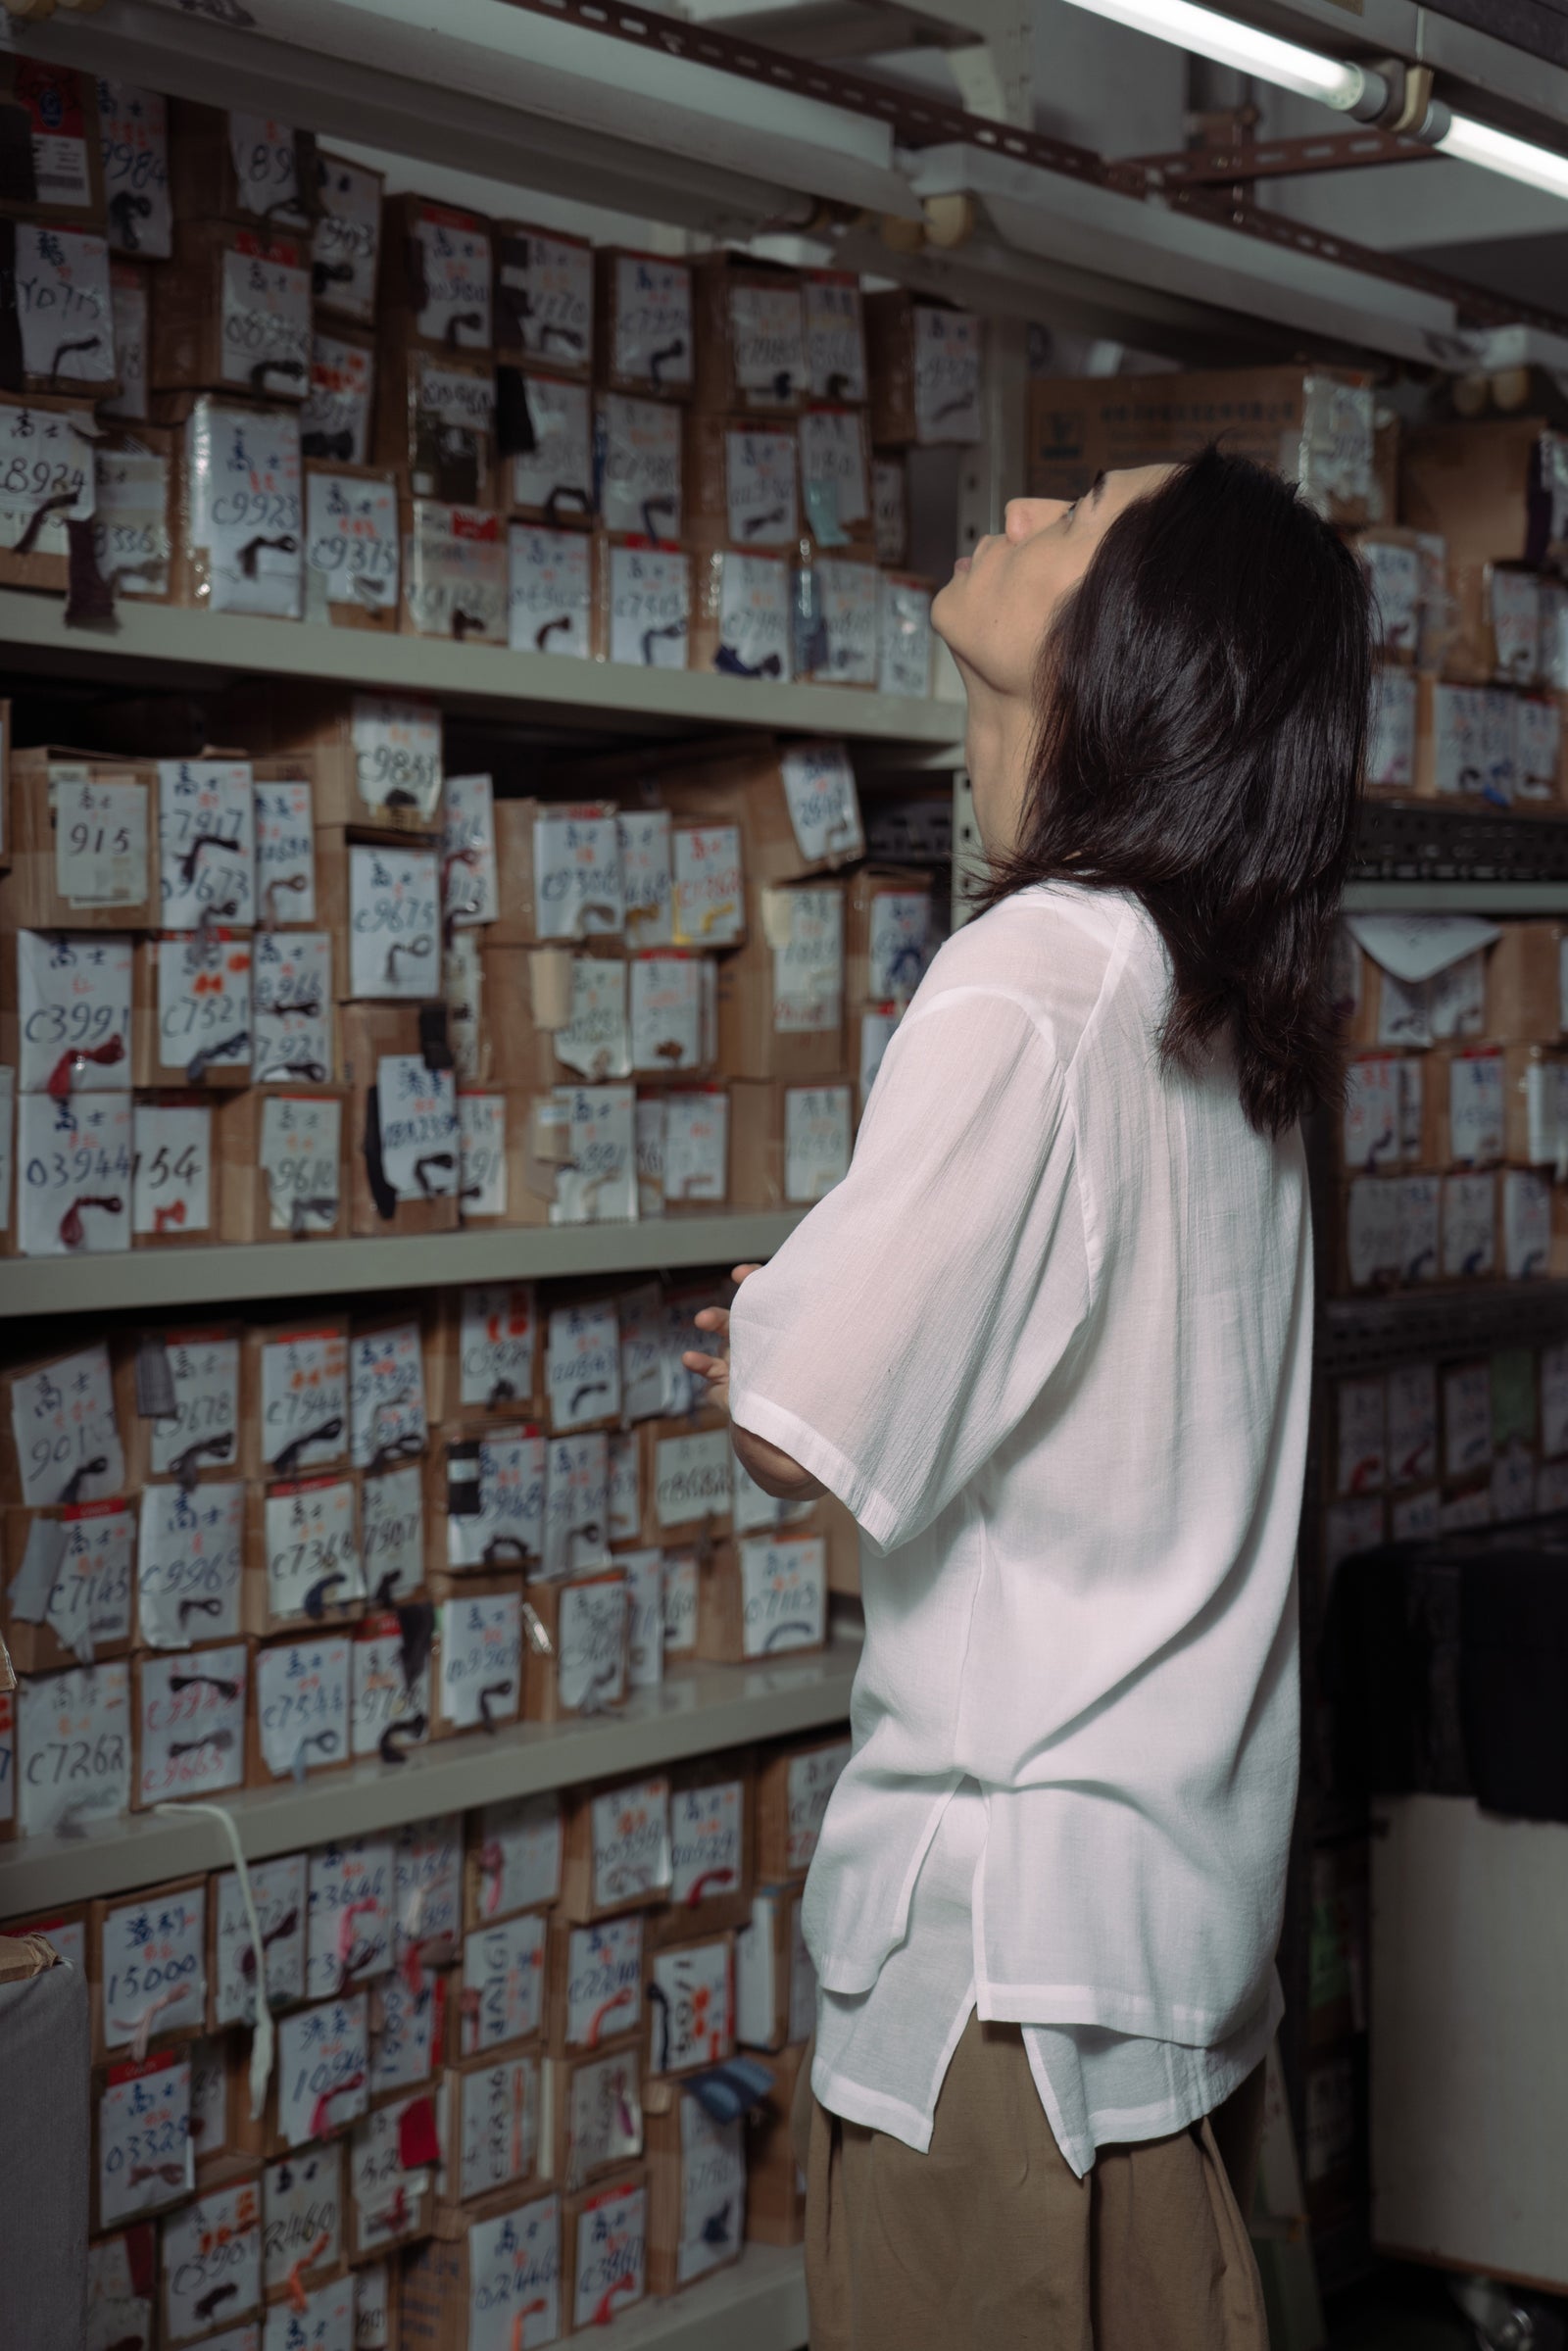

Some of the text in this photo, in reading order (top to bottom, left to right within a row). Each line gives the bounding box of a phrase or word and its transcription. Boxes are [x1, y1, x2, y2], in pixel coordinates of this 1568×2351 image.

[69, 822, 131, 856] 915
[24, 1002, 128, 1044] C3991
[107, 1953, 198, 2006] 15000
